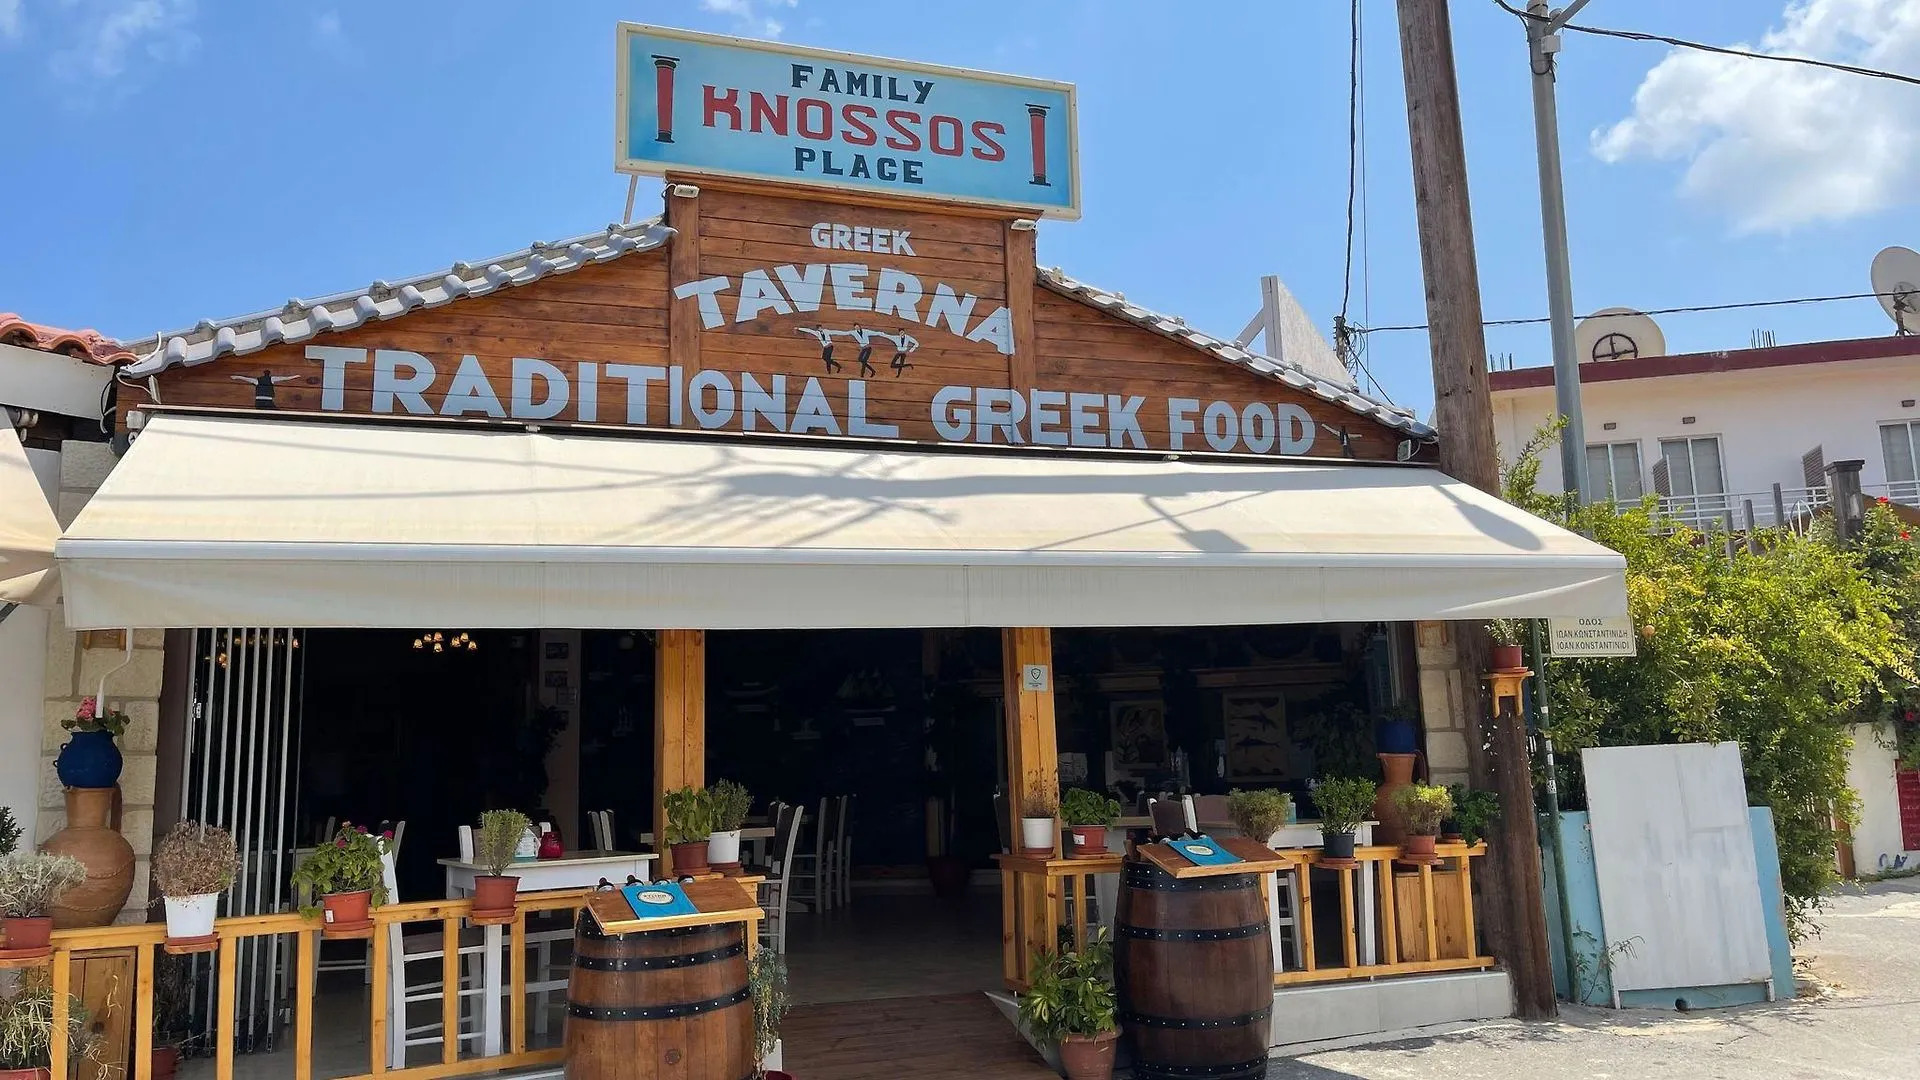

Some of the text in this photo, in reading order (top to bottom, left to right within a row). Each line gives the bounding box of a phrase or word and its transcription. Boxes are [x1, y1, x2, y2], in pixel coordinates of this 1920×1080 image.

[791, 64, 934, 104] FAMILY
[702, 85, 1006, 162] KNOSSOS
[795, 147, 924, 184] PLACE
[810, 222, 916, 257] GREEK
[673, 263, 1015, 355] TAVERNA
[305, 345, 1316, 456] TRADITIONAL GREEK FOOD
[1578, 618, 1603, 626] ΟΔΟΣ
